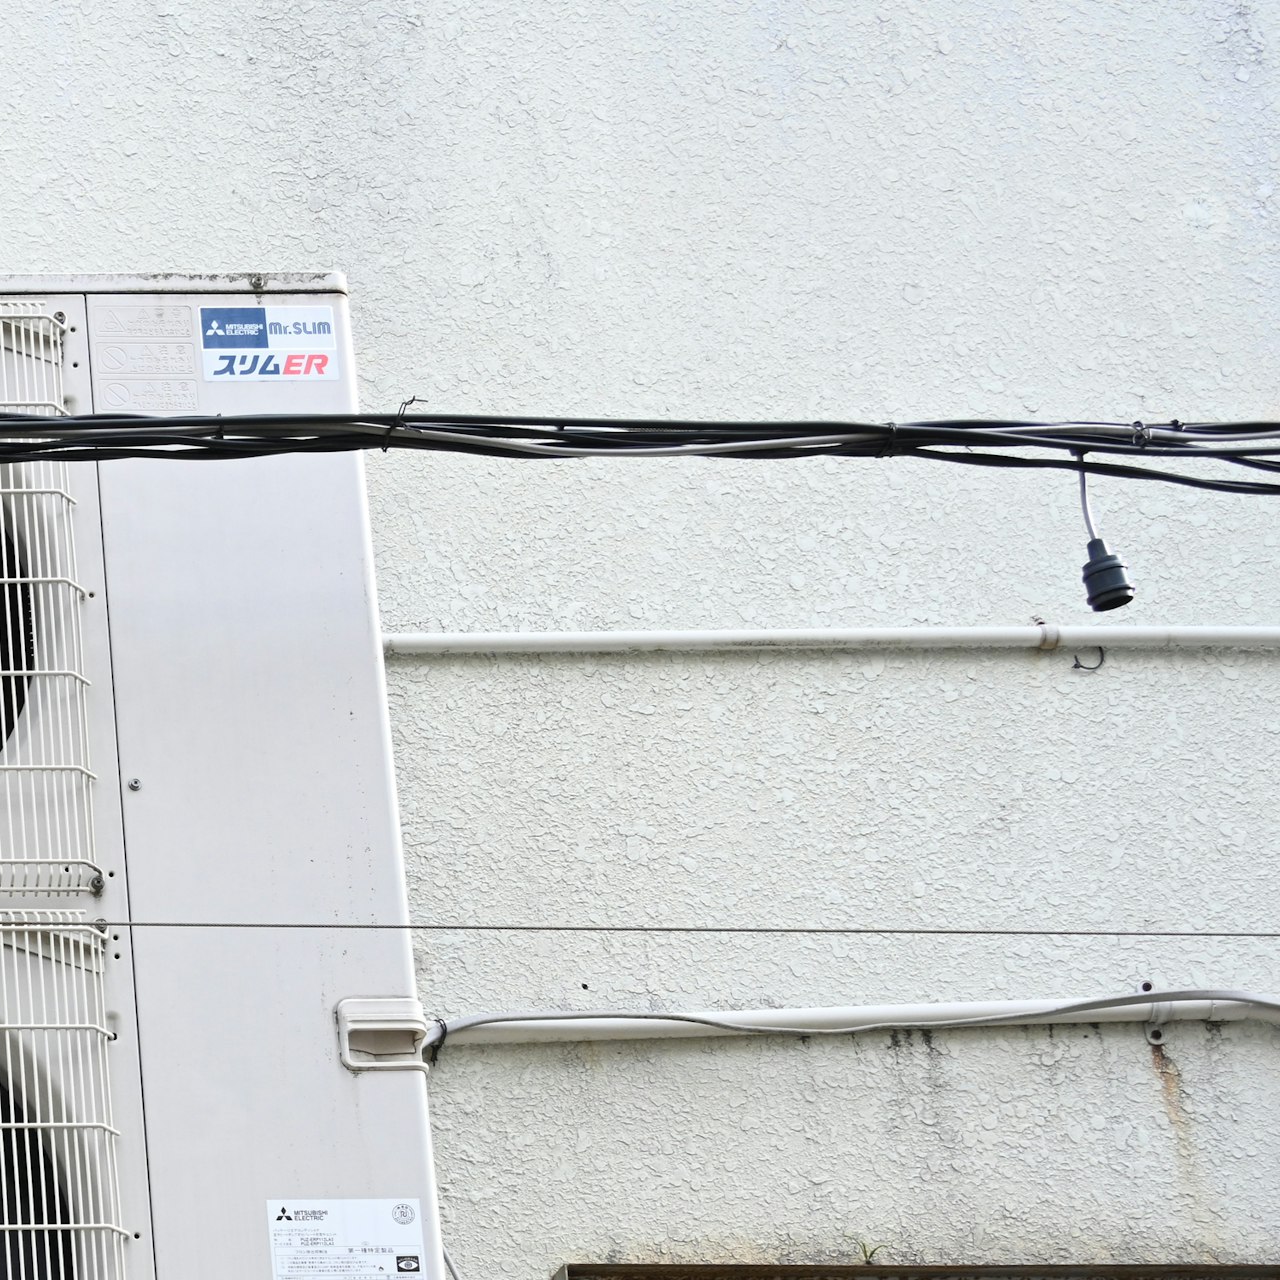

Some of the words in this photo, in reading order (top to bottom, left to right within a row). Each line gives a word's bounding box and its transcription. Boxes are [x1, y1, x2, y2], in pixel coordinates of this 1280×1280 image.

[268, 321, 331, 335] Mr.SLIM
[213, 354, 329, 376] スリムER
